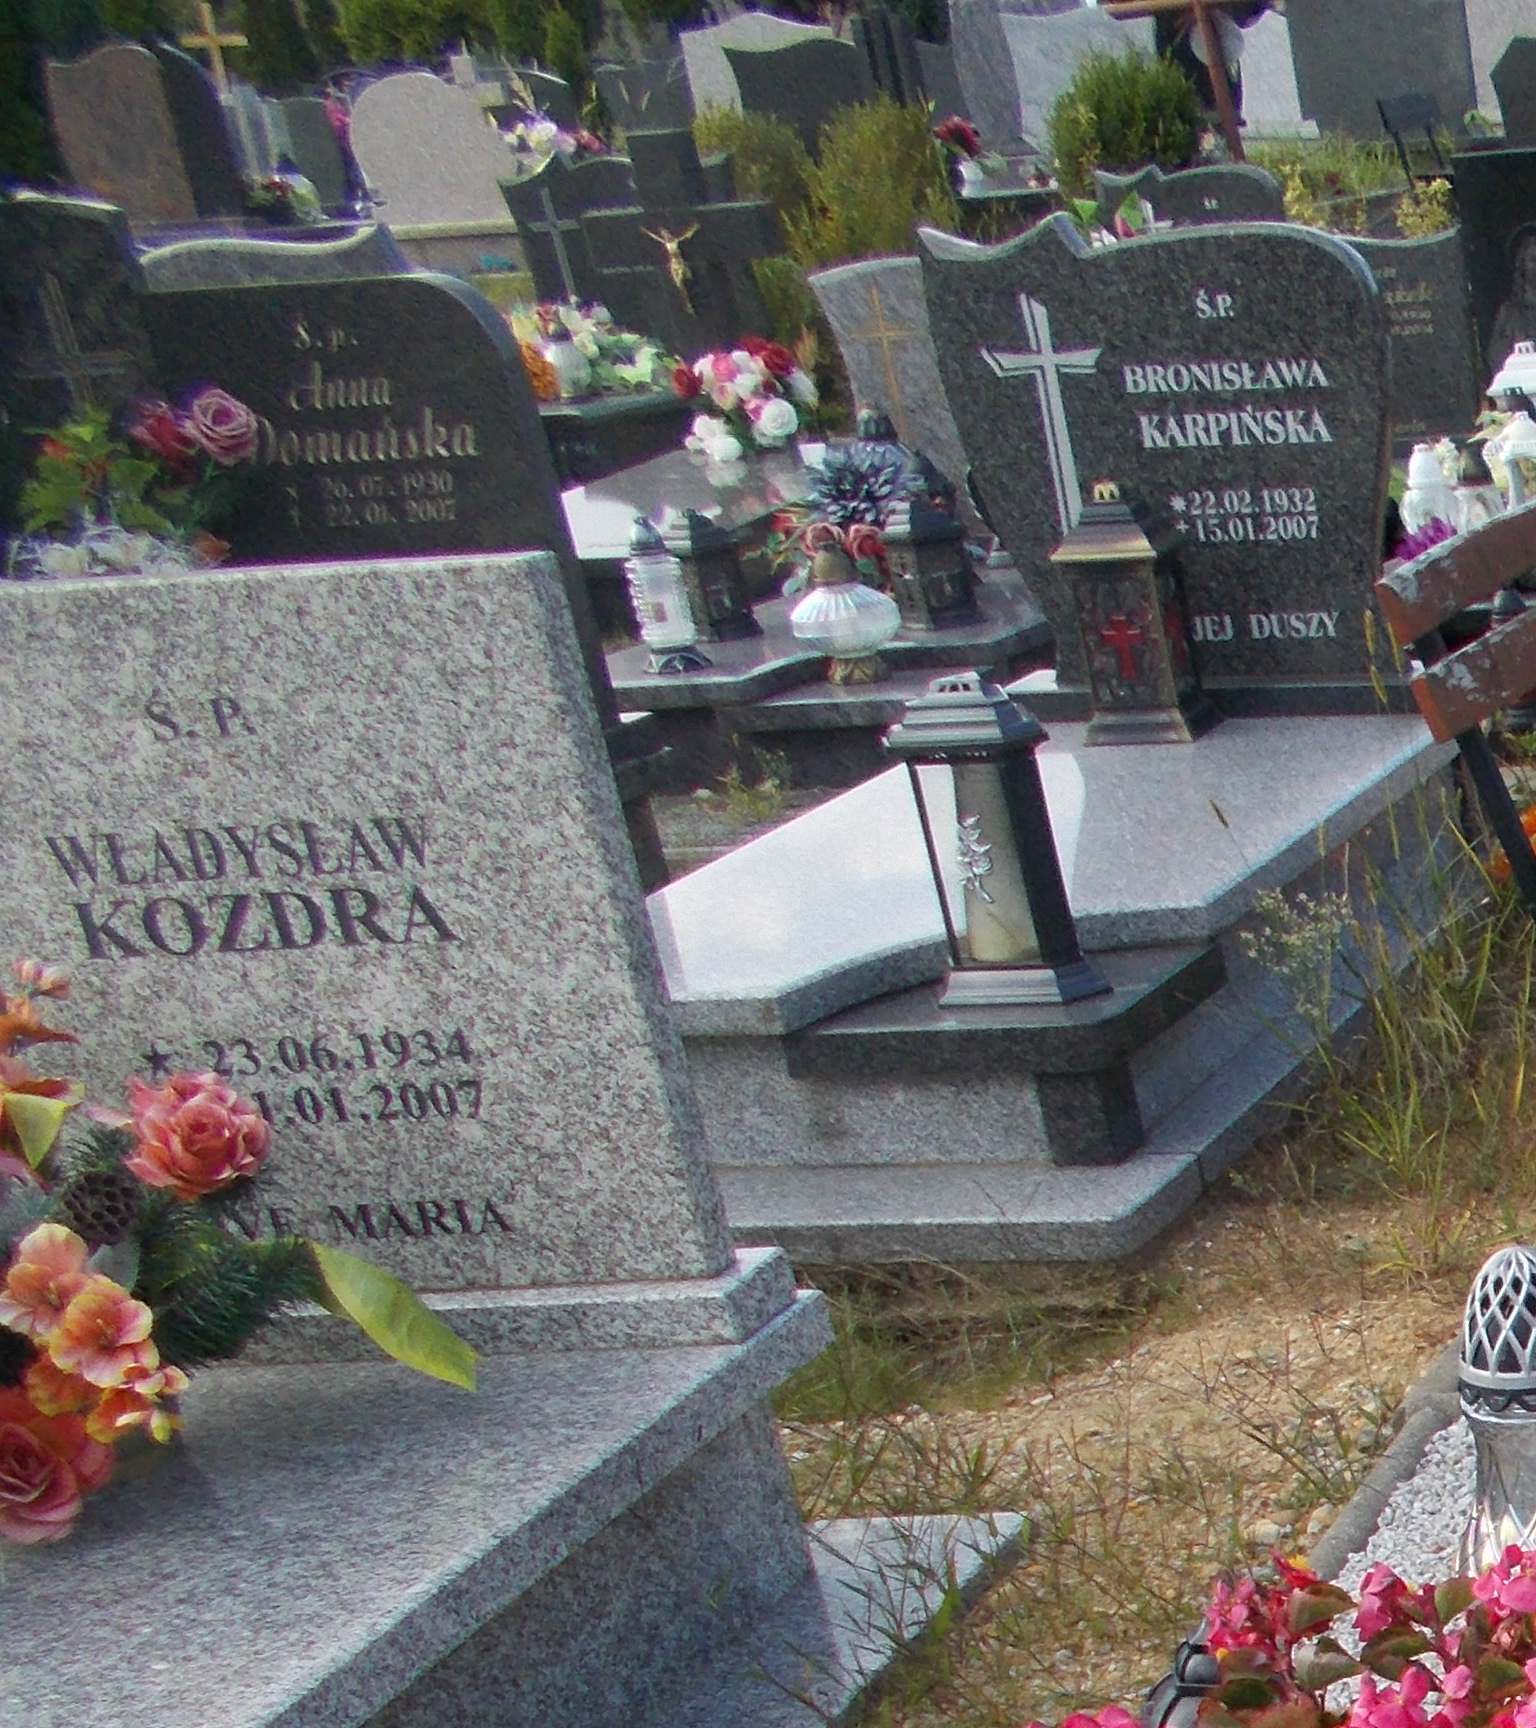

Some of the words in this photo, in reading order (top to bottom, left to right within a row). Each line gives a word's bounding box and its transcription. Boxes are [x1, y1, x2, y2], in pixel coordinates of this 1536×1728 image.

[289, 361, 392, 411] Anna
[1123, 358, 1329, 393] BRONISŁAWA
[1138, 405, 1333, 448] KARPIŃSKA
[1191, 614, 1234, 641] JEJ
[1250, 611, 1340, 639] DUSZY
[70, 884, 464, 961] KOZDRA
[204, 1027, 474, 1076] 23.06.1934
[253, 1078, 486, 1124] 1.01.2007
[329, 1199, 516, 1240] MARIA
